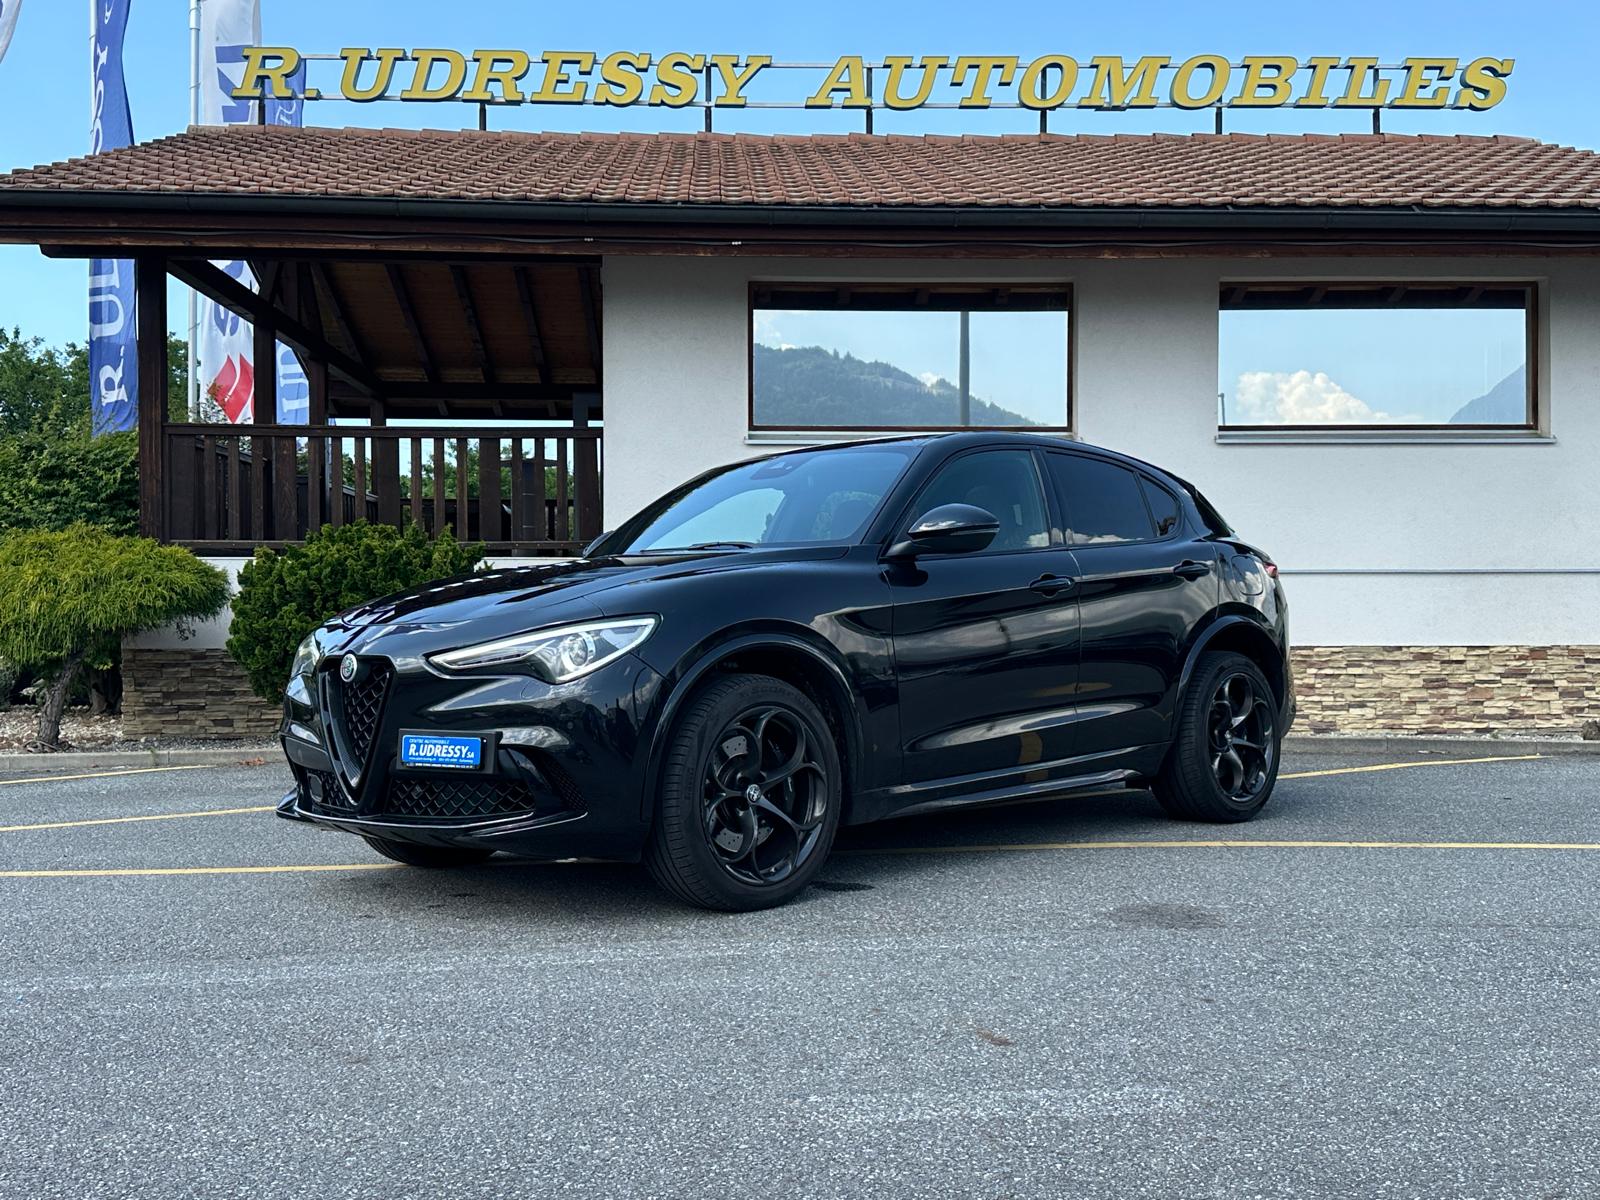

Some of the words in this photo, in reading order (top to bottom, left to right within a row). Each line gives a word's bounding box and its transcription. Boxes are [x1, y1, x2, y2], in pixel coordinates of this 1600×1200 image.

[805, 55, 1515, 111] AUTOMOBILES
[408, 743, 469, 758] R.UDRESSY
[466, 751, 475, 759] SA
